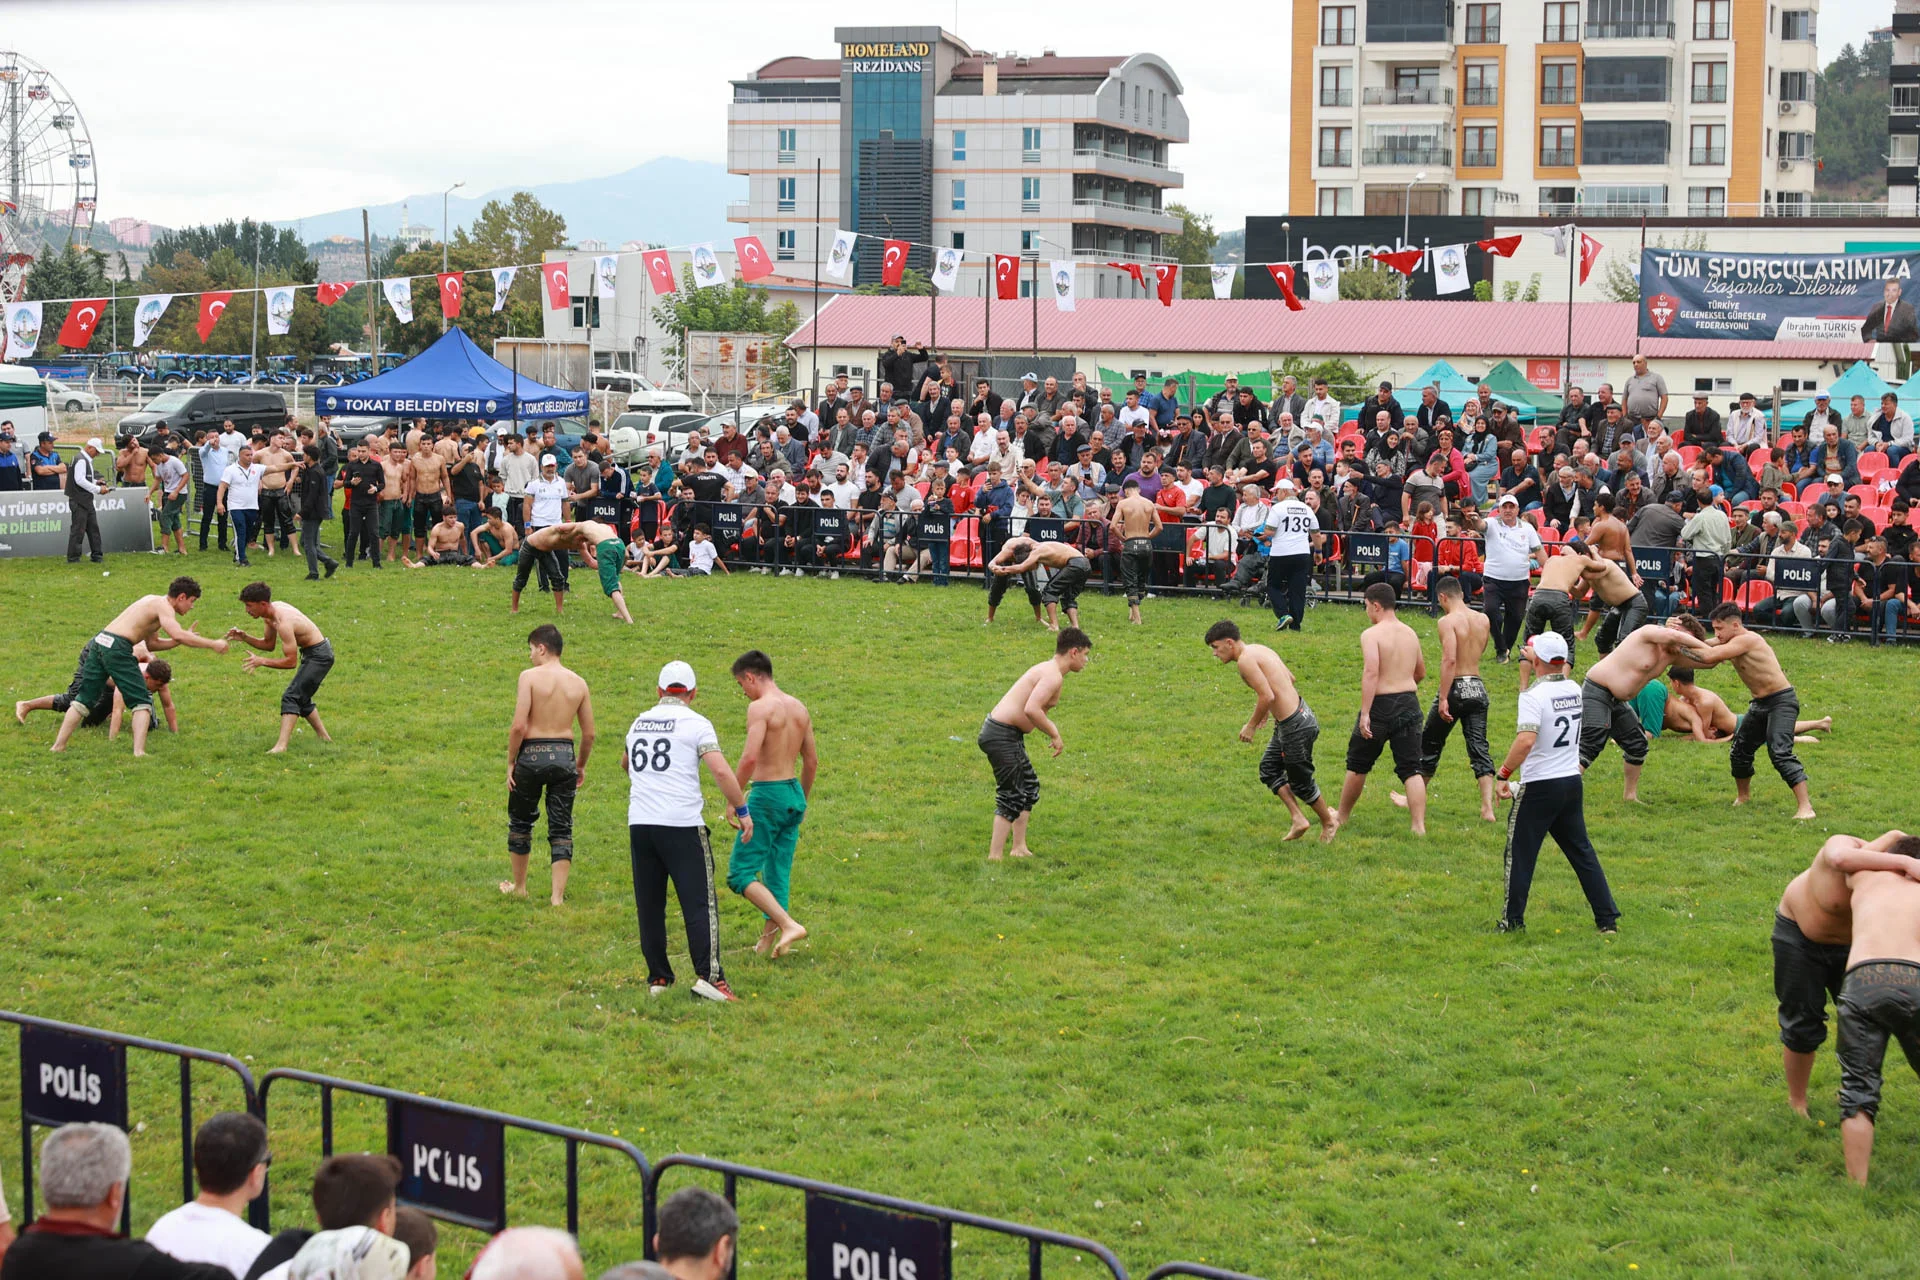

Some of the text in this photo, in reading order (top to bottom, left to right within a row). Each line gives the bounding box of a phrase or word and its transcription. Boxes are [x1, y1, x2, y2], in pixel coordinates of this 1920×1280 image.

[844, 43, 930, 58] HOMELAND
[853, 59, 921, 72] REZİDANS
[1303, 237, 1429, 273] bambi
[1655, 252, 1911, 279] TÜM SPORCULARIMIZA
[1703, 274, 1858, 299] Başarılar Dilerim
[1708, 300, 1740, 310] TÜRKİYE
[1680, 310, 1726, 320] GELENEKSEL
[1696, 321, 1749, 330] FEDERASYONU
[1787, 320, 1857, 334] İbrahim TÜRKİŞ
[344, 399, 479, 413] TOKAT BELEDİYESİ
[525, 400, 577, 414] TOKAT BELEDİYESİ
[8, 500, 38, 516] TÜM
[594, 505, 615, 516] POLİS
[10, 518, 61, 534] DİLERİM
[820, 516, 839, 527] POLİS
[924, 523, 944, 533] POLİS
[1282, 516, 1311, 533] 139
[1356, 545, 1380, 556] POLİS
[1783, 568, 1811, 581] POLİS
[635, 720, 674, 731] ÖZÜNLÜ
[1553, 713, 1582, 748] 27
[632, 738, 671, 772] 68
[40, 1062, 102, 1105] POLİS
[833, 1242, 917, 1280] POLİS
